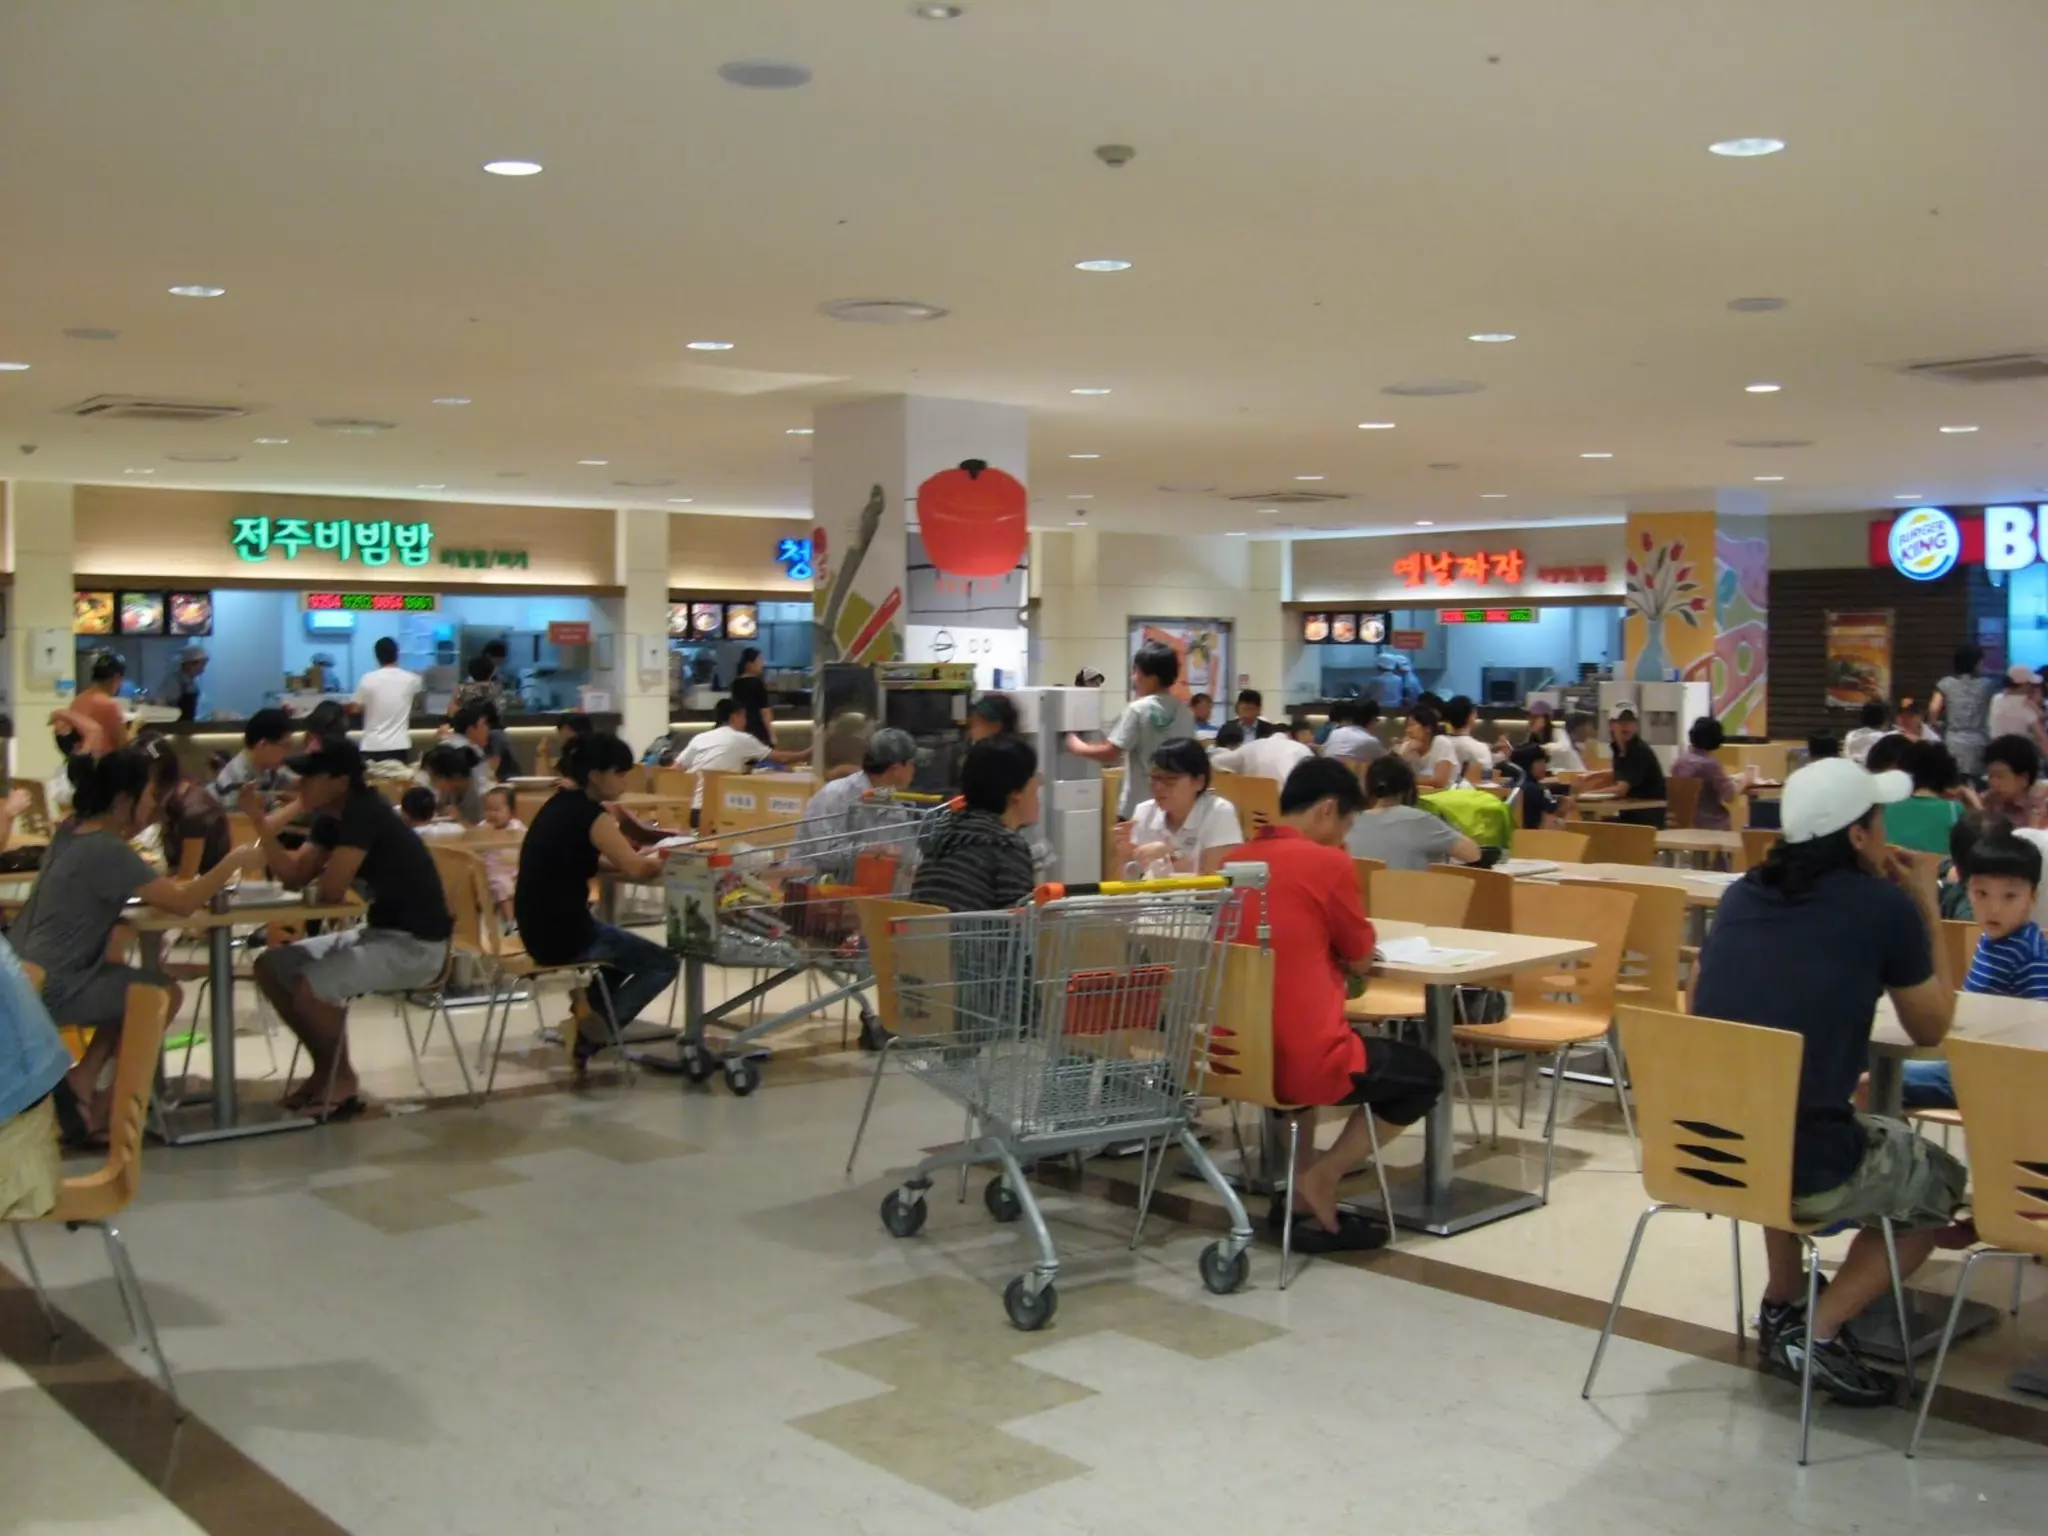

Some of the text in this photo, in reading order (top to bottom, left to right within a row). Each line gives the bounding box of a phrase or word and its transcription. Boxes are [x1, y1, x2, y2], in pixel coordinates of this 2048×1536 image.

[231, 515, 434, 568] 전주비빔밥
[1900, 532, 1948, 561] KING
[1984, 504, 2048, 570] B
[1392, 548, 1525, 587] 옛날짜장
